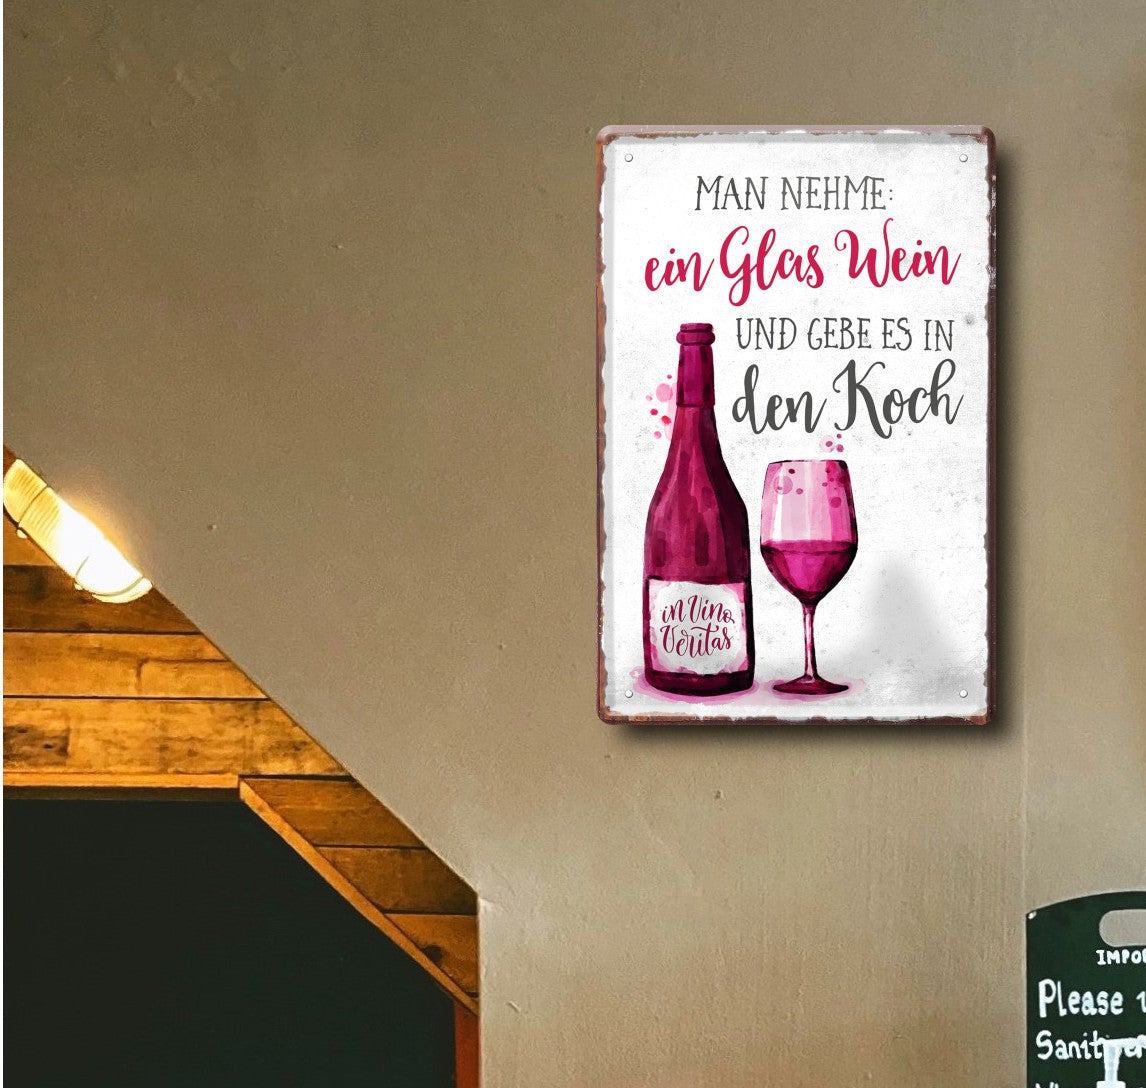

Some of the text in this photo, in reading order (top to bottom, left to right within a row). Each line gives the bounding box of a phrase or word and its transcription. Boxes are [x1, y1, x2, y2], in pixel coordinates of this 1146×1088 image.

[694, 175, 894, 211] MAN NEHME:
[644, 217, 960, 307] ein Glas Wein
[735, 317, 954, 352] UND GEBE ES IN
[732, 358, 964, 438] den Koch
[662, 594, 735, 624] in Vino
[660, 622, 734, 658] Veritas
[1038, 978, 1124, 1018] Please
